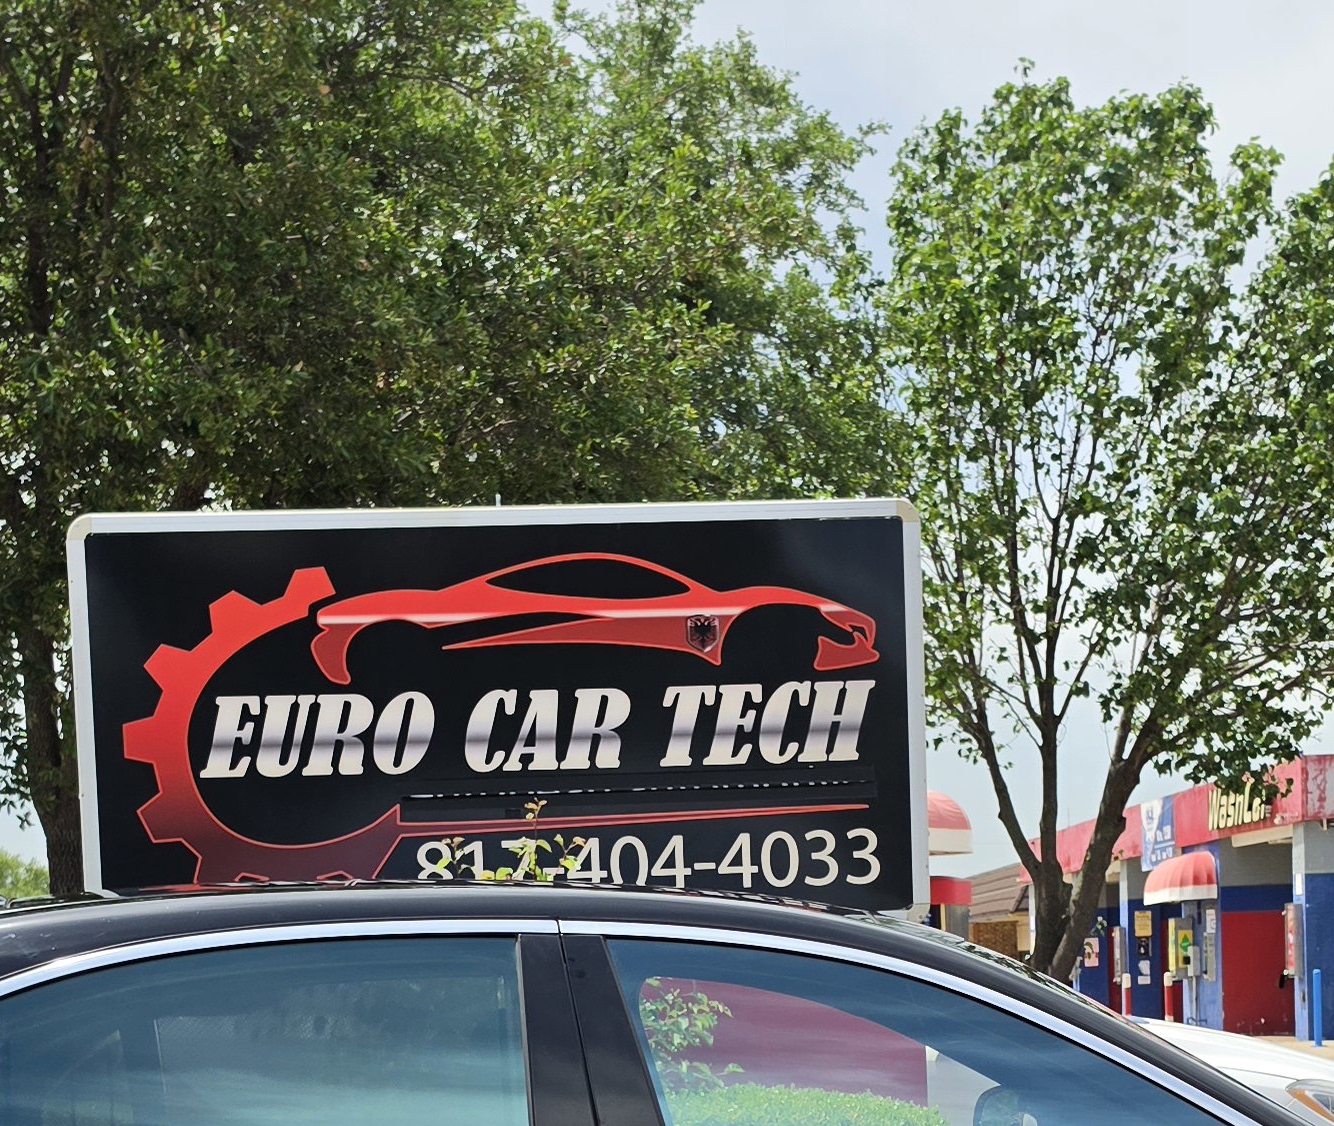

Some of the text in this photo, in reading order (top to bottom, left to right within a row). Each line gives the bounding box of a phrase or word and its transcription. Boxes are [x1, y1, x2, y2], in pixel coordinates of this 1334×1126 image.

[199, 679, 876, 779] EURO CAR TECH
